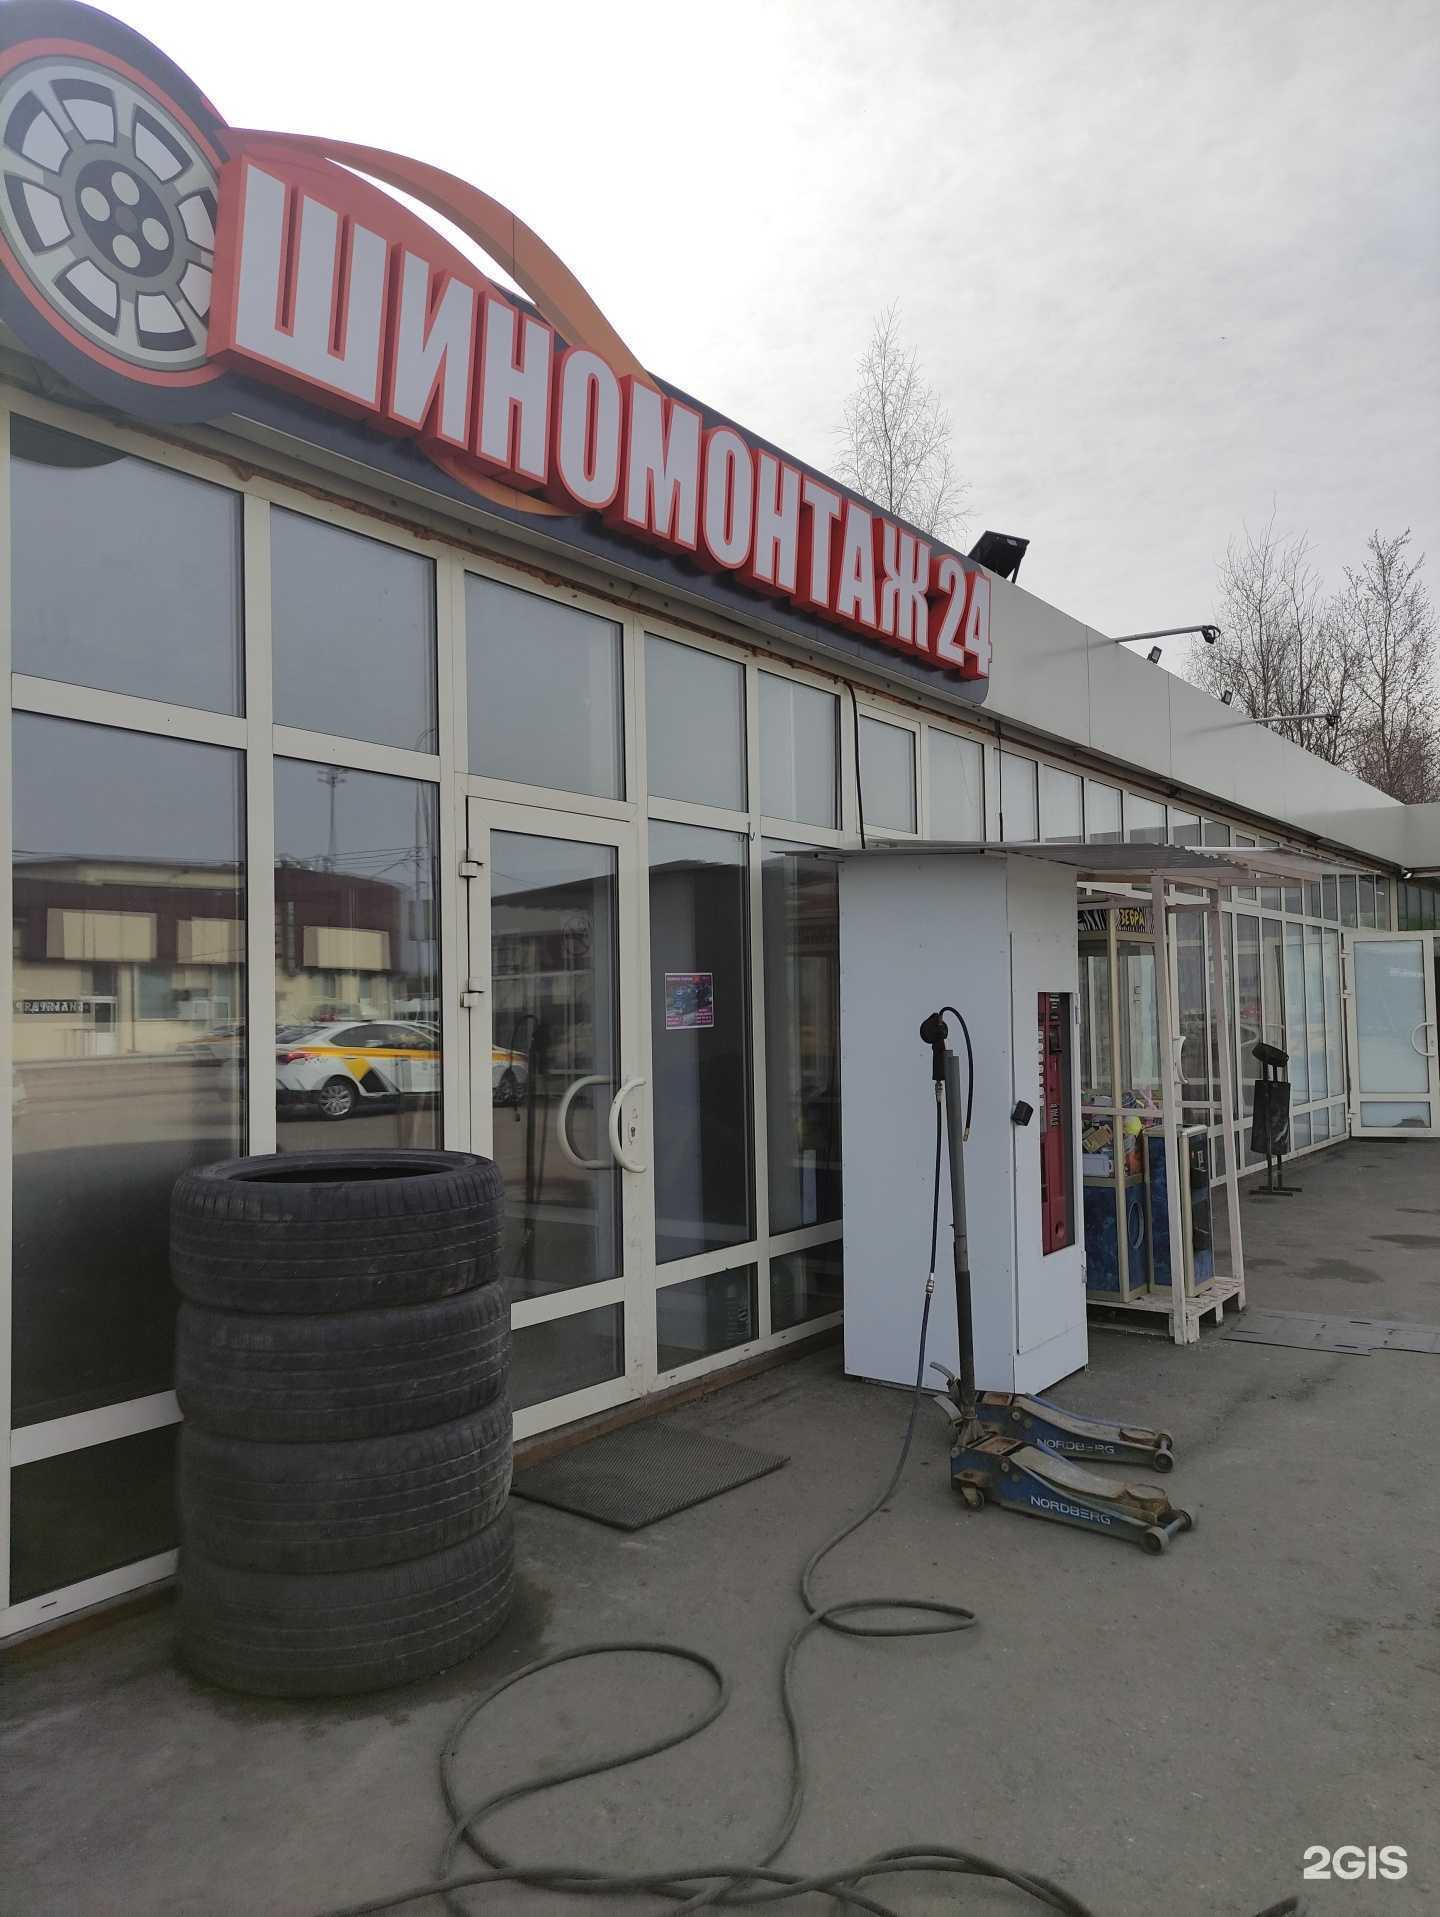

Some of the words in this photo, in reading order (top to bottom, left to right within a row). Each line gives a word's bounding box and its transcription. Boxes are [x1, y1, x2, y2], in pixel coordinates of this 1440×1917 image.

[230, 156, 932, 653] ШИНОМОНТАЖ
[935, 555, 993, 680] 24
[1119, 908, 1146, 926] ЗЕБРА
[1030, 1495, 1111, 1525] NORDBERG
